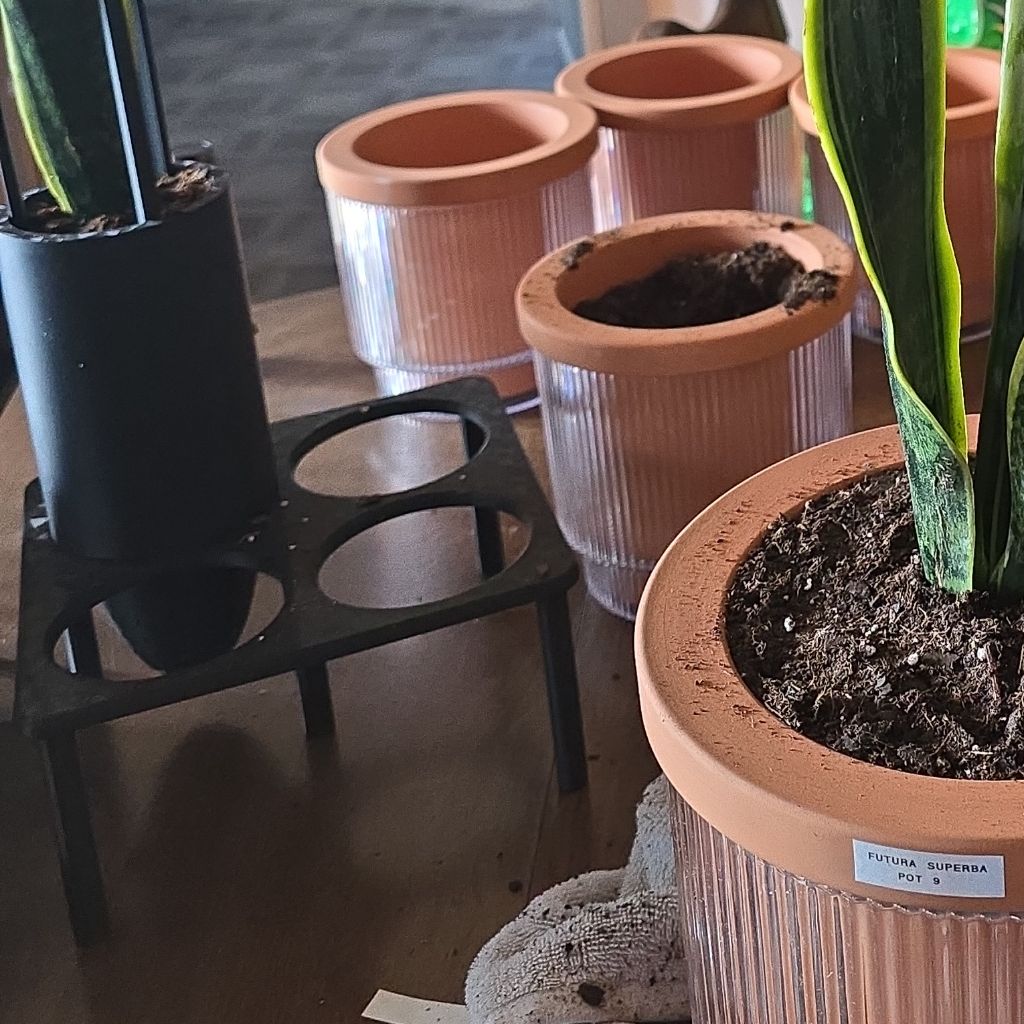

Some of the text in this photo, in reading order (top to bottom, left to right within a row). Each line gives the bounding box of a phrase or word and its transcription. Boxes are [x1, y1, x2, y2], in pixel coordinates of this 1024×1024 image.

[868, 852, 988, 873] FUTURA SUPERBA
[898, 873, 940, 885] POT 9
